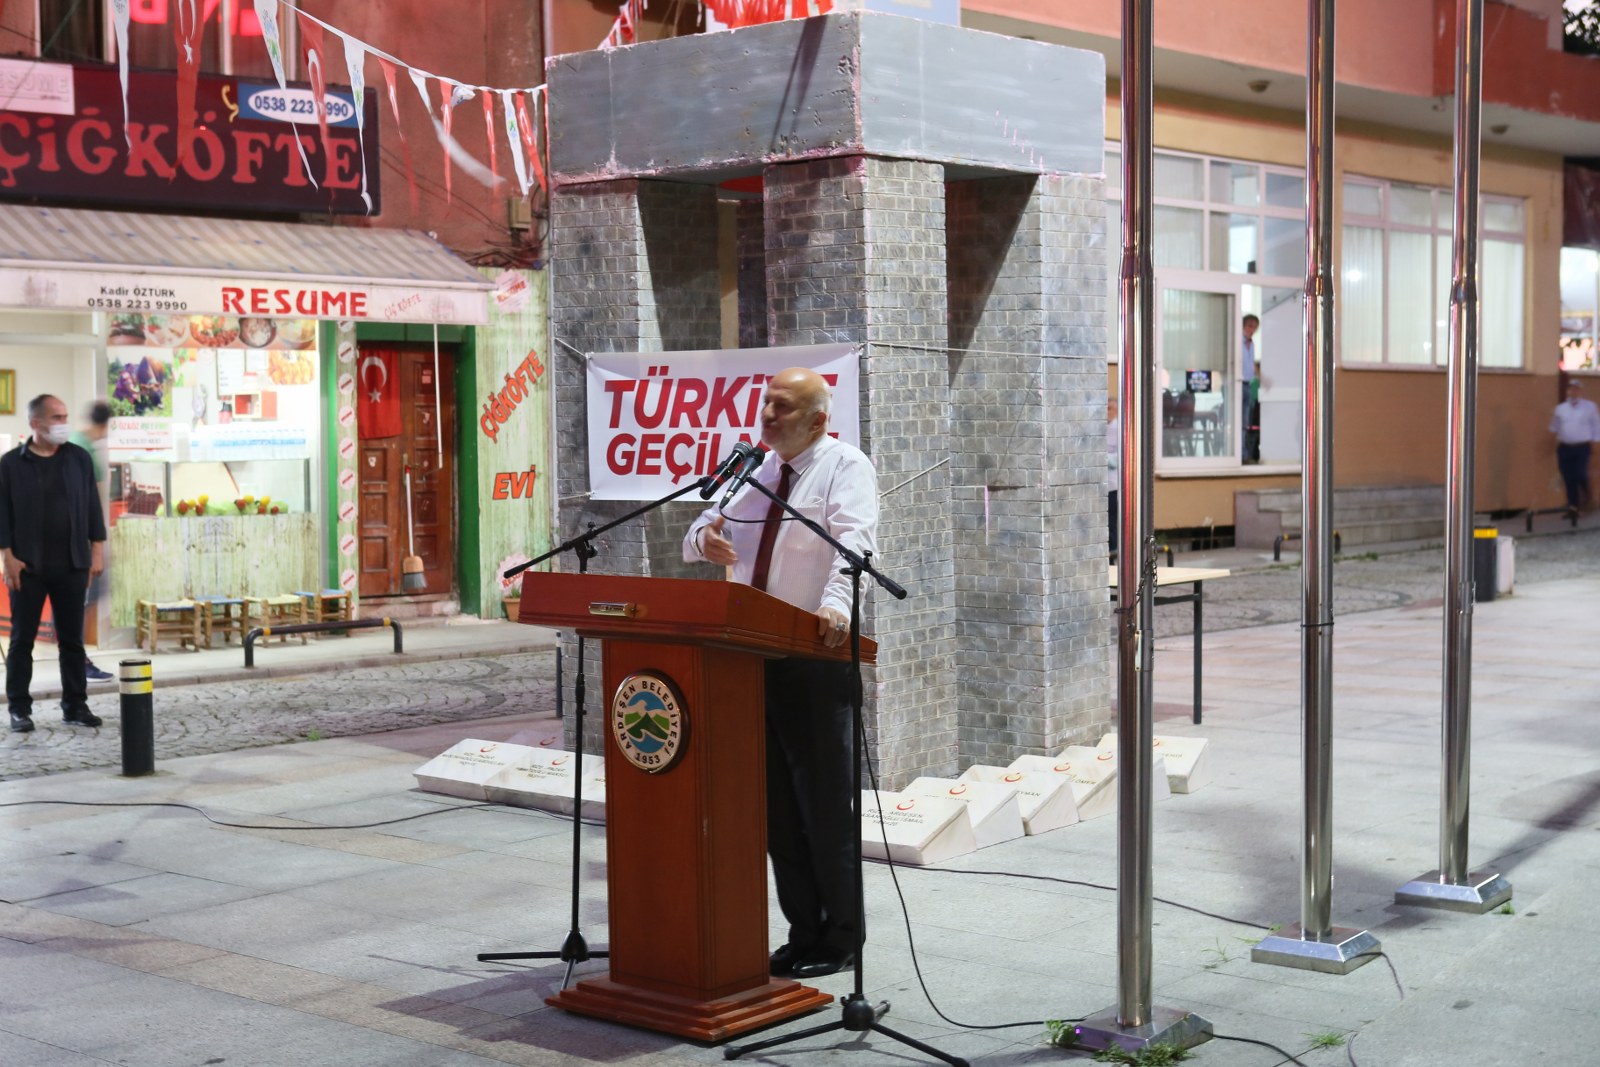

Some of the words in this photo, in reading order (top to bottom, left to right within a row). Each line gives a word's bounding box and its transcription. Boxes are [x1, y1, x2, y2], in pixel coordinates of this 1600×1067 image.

[254, 95, 287, 111] 0538
[290, 99, 315, 114] 223
[318, 101, 348, 117] 990
[100, 286, 129, 297] Kadir
[88, 298, 121, 309] 0538
[127, 300, 151, 310] 223
[156, 301, 188, 311] 9990
[222, 286, 368, 317] RESUME
[492, 464, 536, 500] EVİ
[635, 752, 661, 765] 1953
